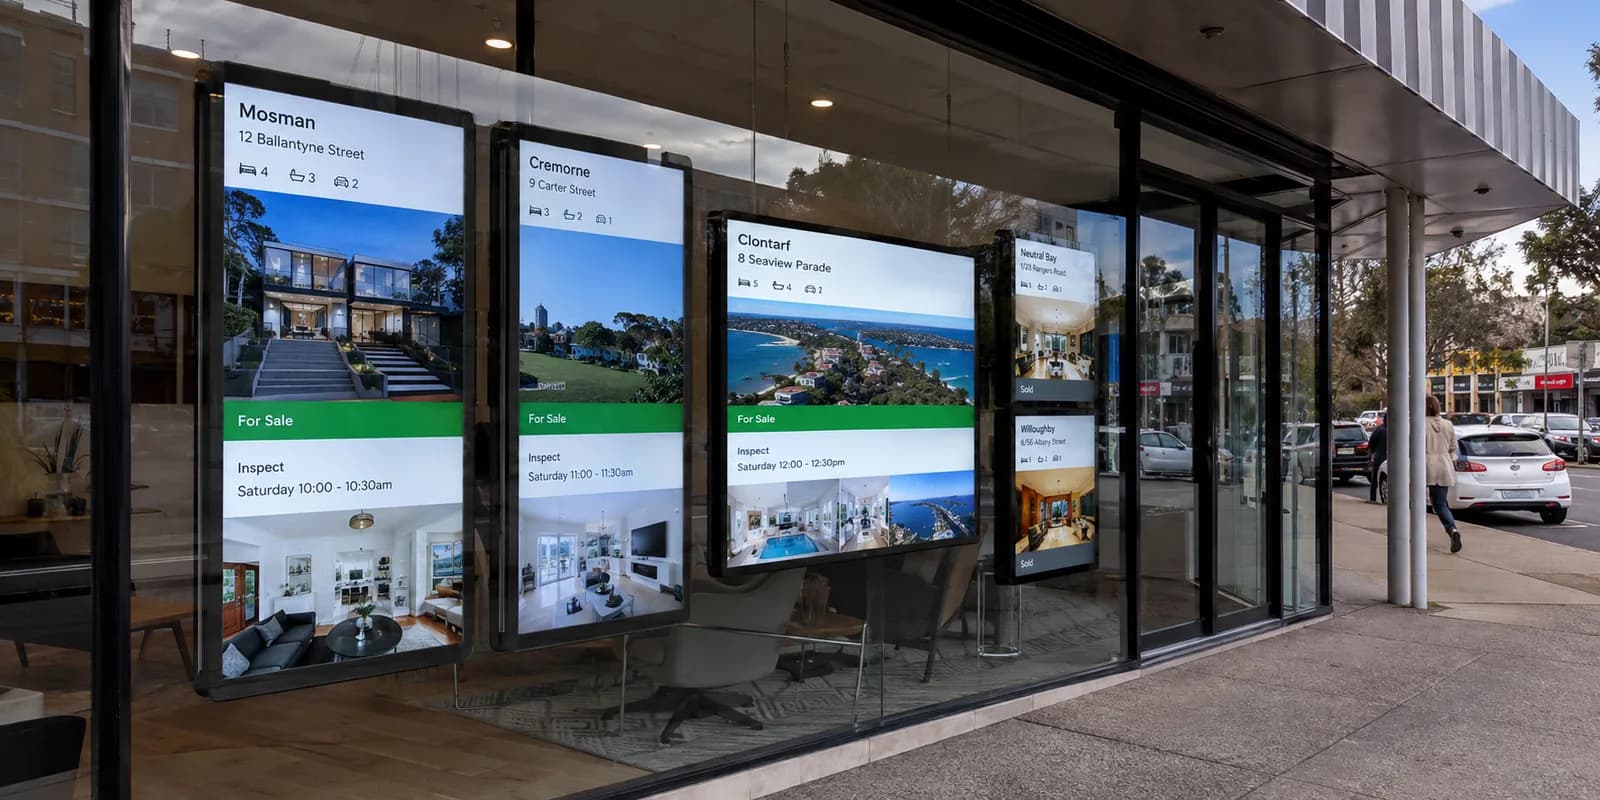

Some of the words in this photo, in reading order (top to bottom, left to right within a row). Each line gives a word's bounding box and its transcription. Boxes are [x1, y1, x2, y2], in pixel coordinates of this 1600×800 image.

[239, 102, 316, 130] Mosman
[239, 130, 253, 143] 12
[257, 132, 325, 155] Ballantyne
[328, 143, 365, 160] Street
[529, 155, 590, 178] Cremorne
[260, 166, 268, 177] 4
[308, 172, 316, 183] 3
[352, 178, 359, 189] 2
[529, 178, 536, 188] 9
[538, 179, 567, 193] Carter
[569, 184, 596, 198] Street
[544, 207, 550, 217] 3
[577, 212, 583, 221] 2
[738, 233, 791, 251] Clontarf
[738, 253, 745, 263] 8
[749, 254, 793, 269] Seaview
[796, 260, 832, 273] Parade
[1020, 248, 1045, 260] Neutral
[1045, 252, 1057, 264] Bay
[1053, 268, 1067, 277] Road
[753, 279, 759, 288] 5
[786, 283, 792, 291] 4
[818, 286, 823, 294] 2
[1020, 385, 1034, 394] Sold
[238, 415, 261, 427] For
[265, 414, 294, 427] Sale
[528, 413, 544, 424] For
[547, 413, 567, 424] Sale
[737, 415, 753, 424] For
[755, 414, 775, 424] Sale
[1020, 424, 1055, 435] Willoughby
[1052, 438, 1066, 446] Street
[528, 453, 560, 464] Inspect
[737, 447, 769, 457] Inspect
[238, 462, 285, 476] Inspect
[737, 461, 776, 472] Saturday
[779, 460, 803, 469] 12:00
[811, 458, 845, 468] 12:30pm
[528, 470, 568, 482] Saturday
[570, 469, 593, 479] 11:00
[601, 467, 633, 478] 11:30am
[238, 484, 295, 498] Saturday
[299, 481, 333, 495] 10:00
[346, 479, 393, 492] 10:30am
[1020, 558, 1034, 568] Sold
